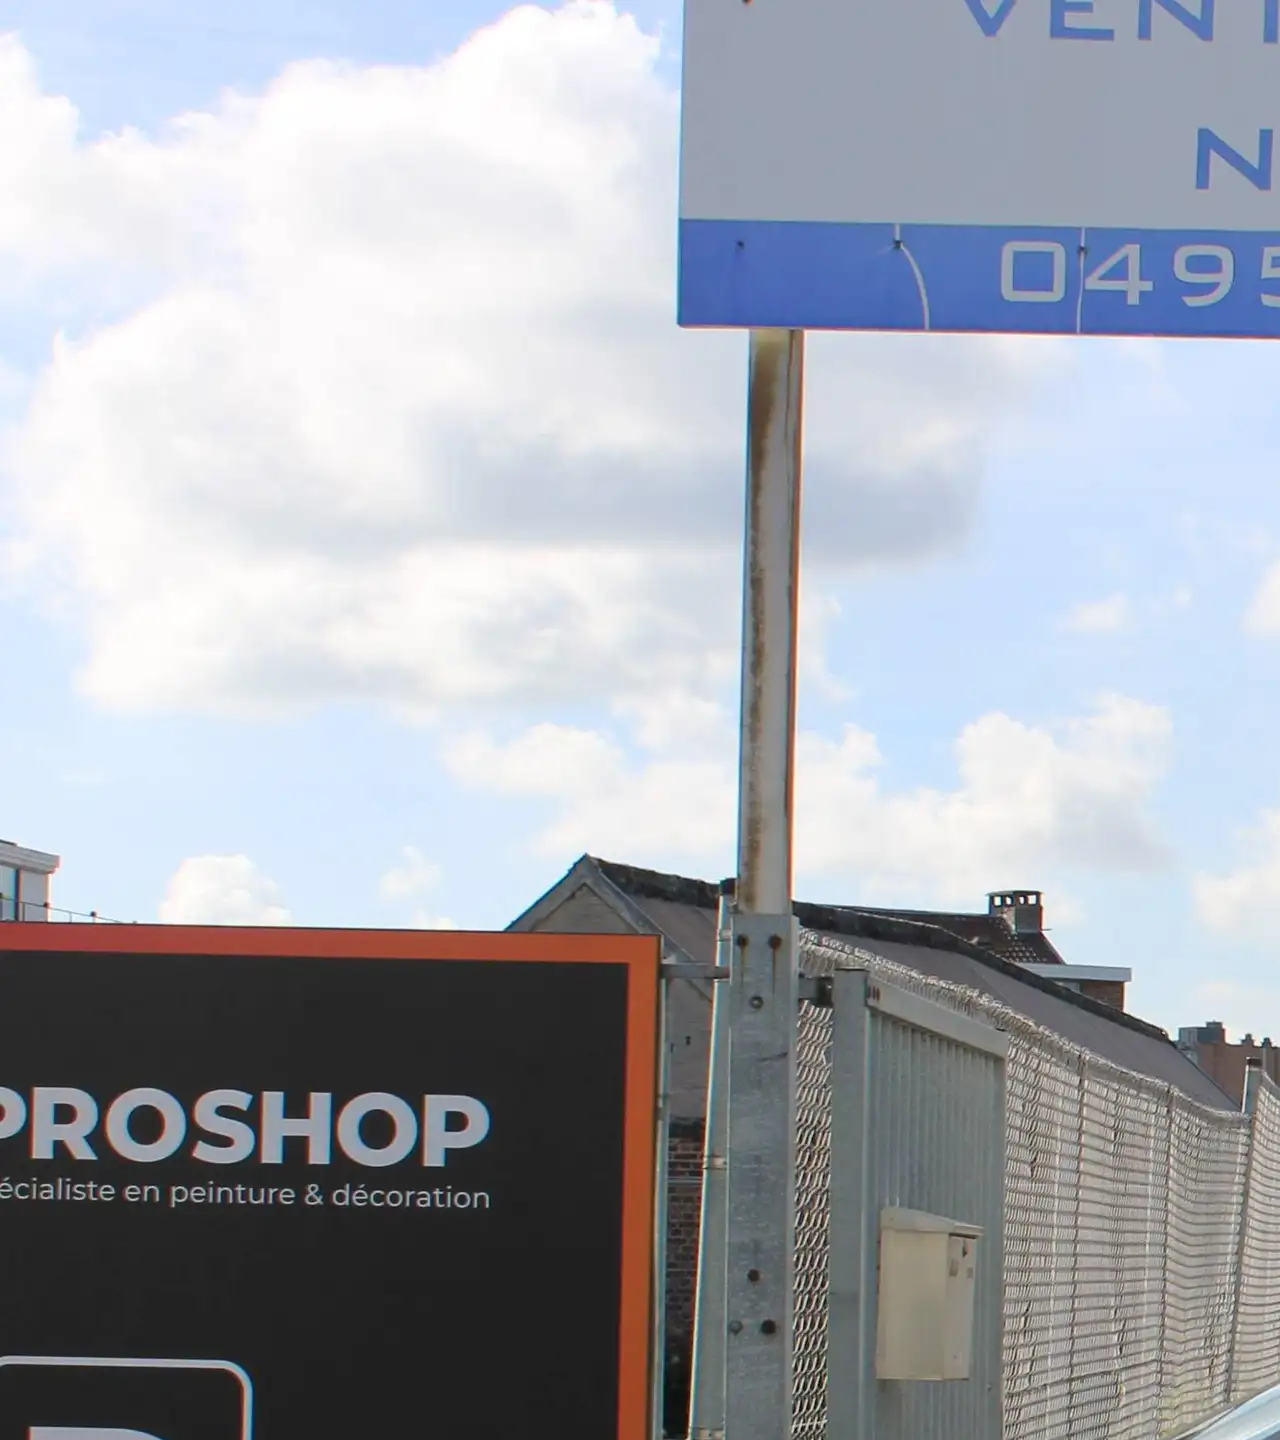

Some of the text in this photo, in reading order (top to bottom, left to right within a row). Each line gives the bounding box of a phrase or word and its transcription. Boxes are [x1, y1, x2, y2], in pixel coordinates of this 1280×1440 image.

[124, 1184, 160, 1202] en
[170, 1181, 296, 1208] peinture
[304, 1183, 323, 1206] &
[332, 1183, 490, 1209] décoration
